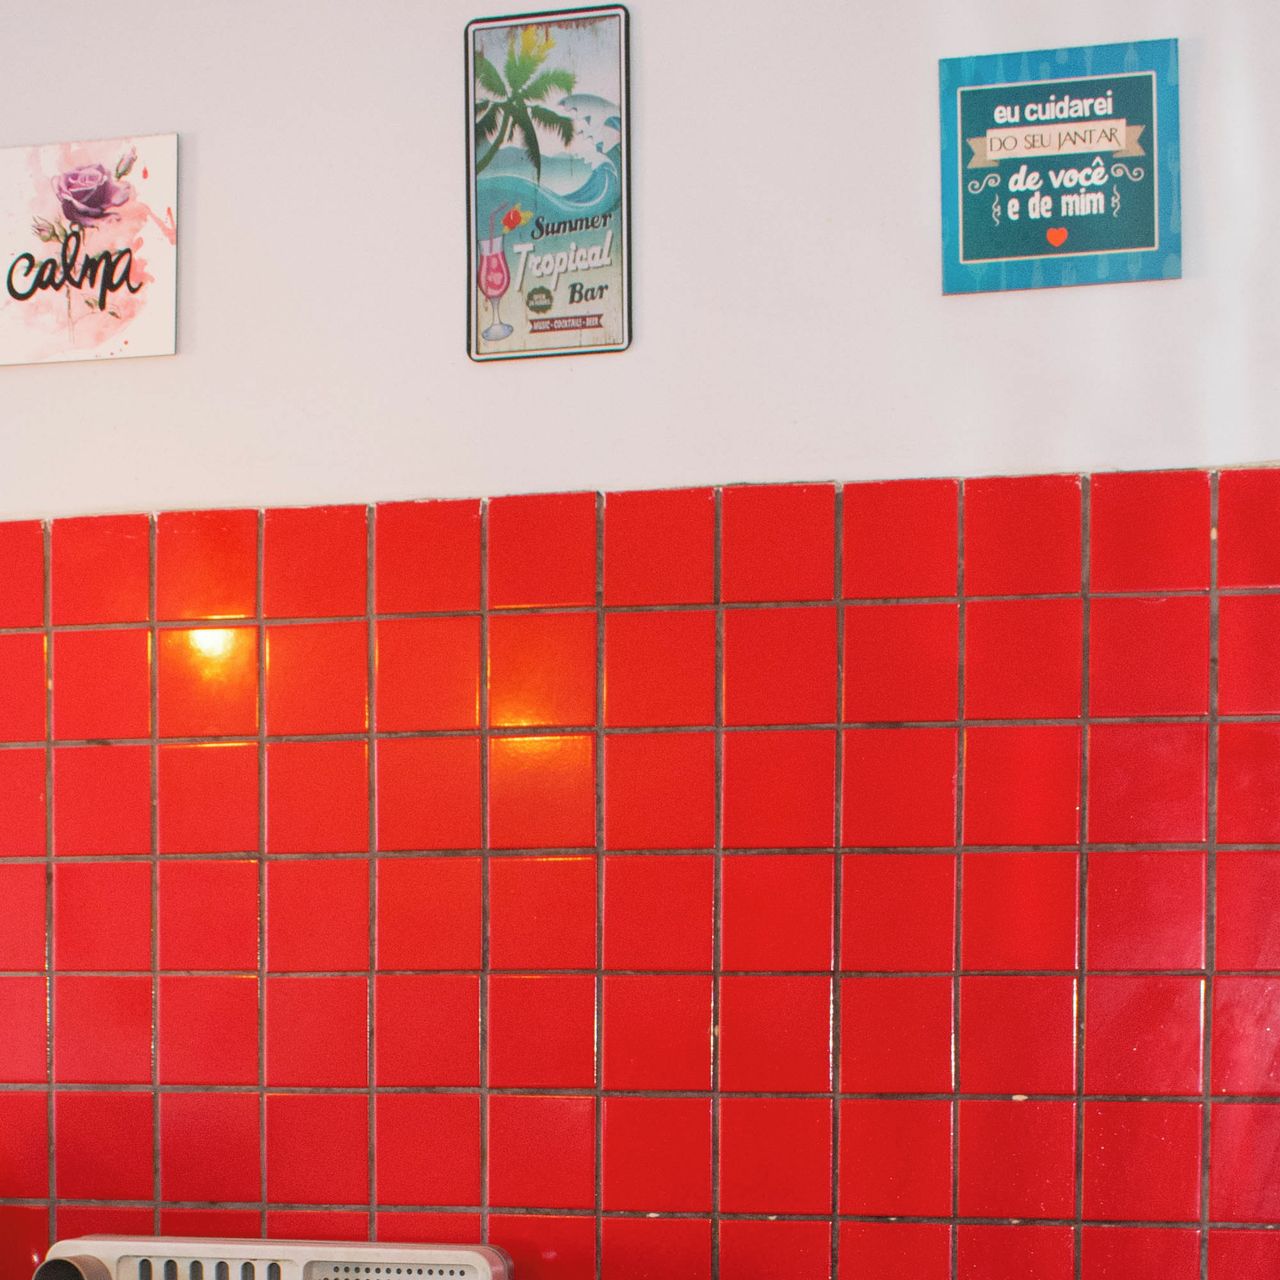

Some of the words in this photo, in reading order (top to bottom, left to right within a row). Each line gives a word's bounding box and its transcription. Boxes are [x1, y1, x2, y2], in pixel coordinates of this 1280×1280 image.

[994, 104, 1020, 124] eu
[1024, 90, 1113, 122] cuidarei
[989, 135, 1018, 152] DO
[1024, 132, 1051, 150] SEU
[1057, 127, 1121, 151] JANTAR
[1008, 164, 1044, 192] de
[1048, 156, 1109, 188] você
[1007, 199, 1020, 220] e
[1028, 191, 1053, 219] de
[1061, 188, 1105, 217] mim
[531, 213, 613, 240] Summer
[513, 230, 613, 293] Tropical
[568, 282, 609, 305] Bar
